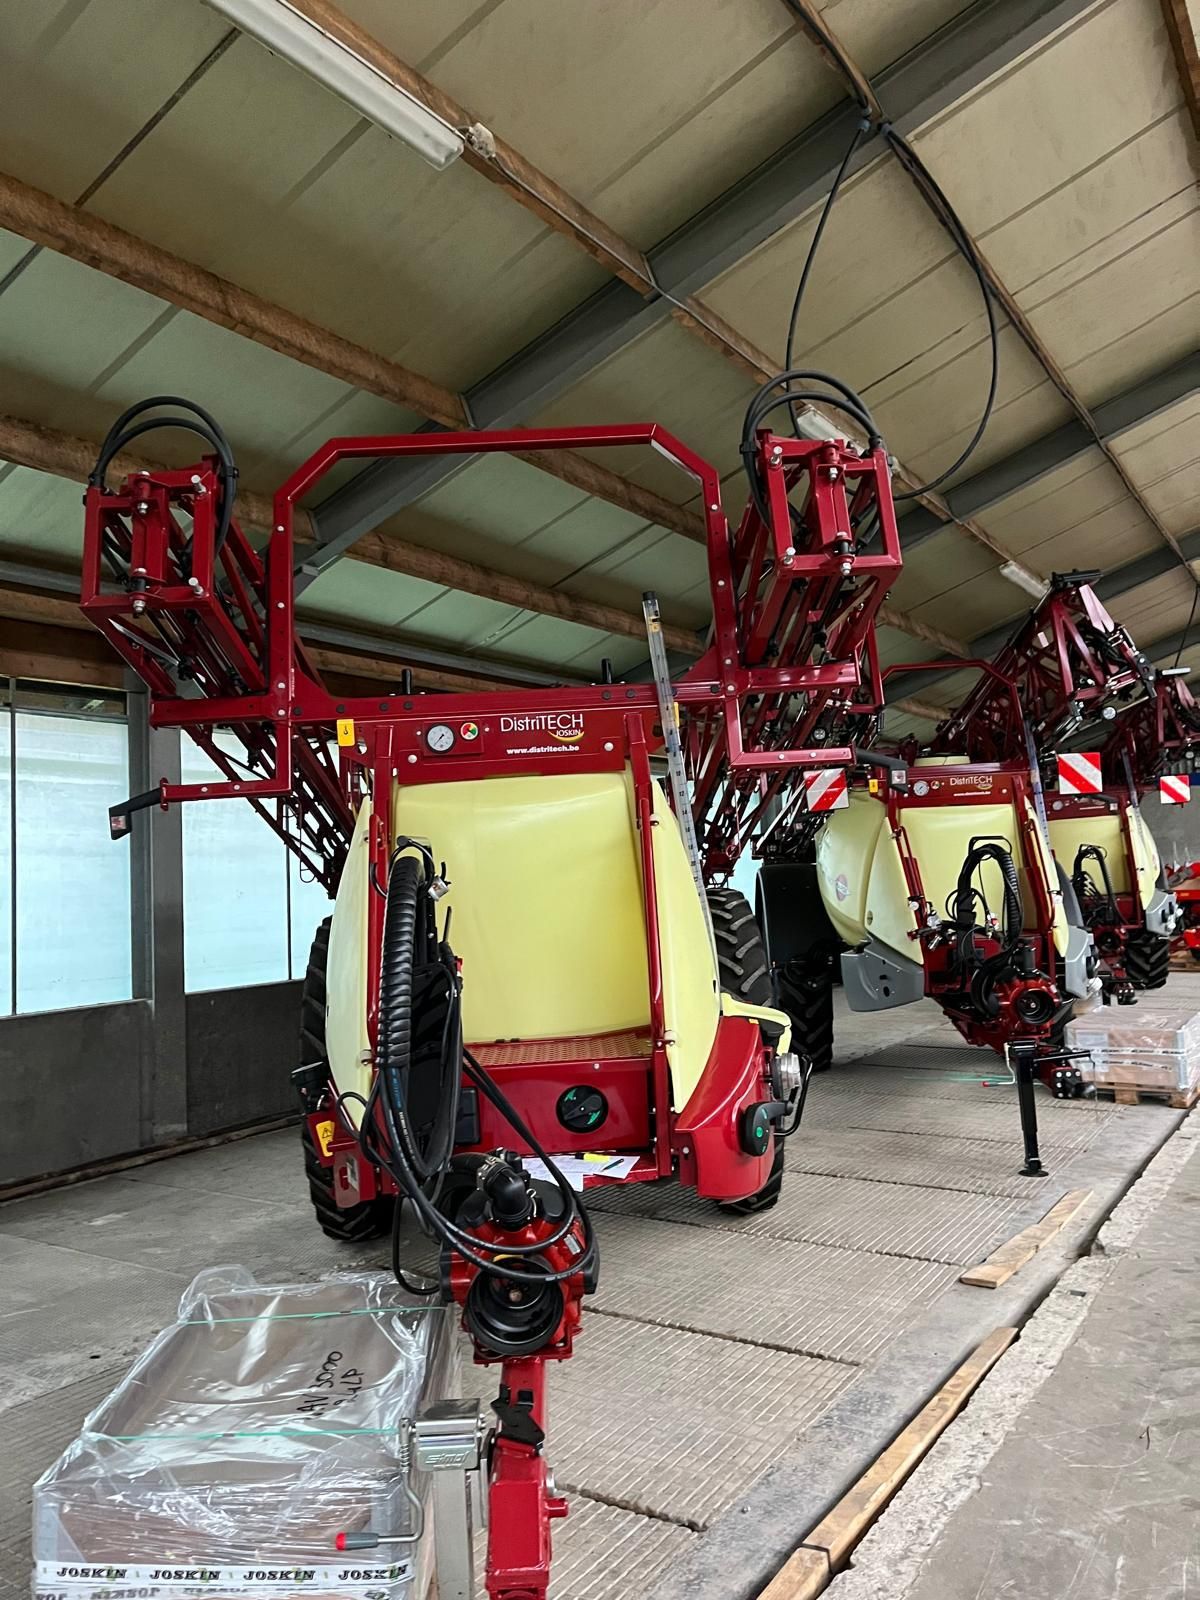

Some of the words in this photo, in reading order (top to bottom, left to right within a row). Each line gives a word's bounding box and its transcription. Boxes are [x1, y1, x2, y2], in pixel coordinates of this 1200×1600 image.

[500, 713, 584, 732] DistriTECH
[556, 729, 581, 737] JOSKIN
[506, 745, 579, 754] www.distritech.be
[308, 1351, 343, 1388] 3000
[56, 1567, 128, 1578] JOSKIN
[149, 1568, 221, 1581] JOSKIN
[243, 1569, 316, 1581] JOSKIN
[337, 1564, 408, 1581] JOSKIN
